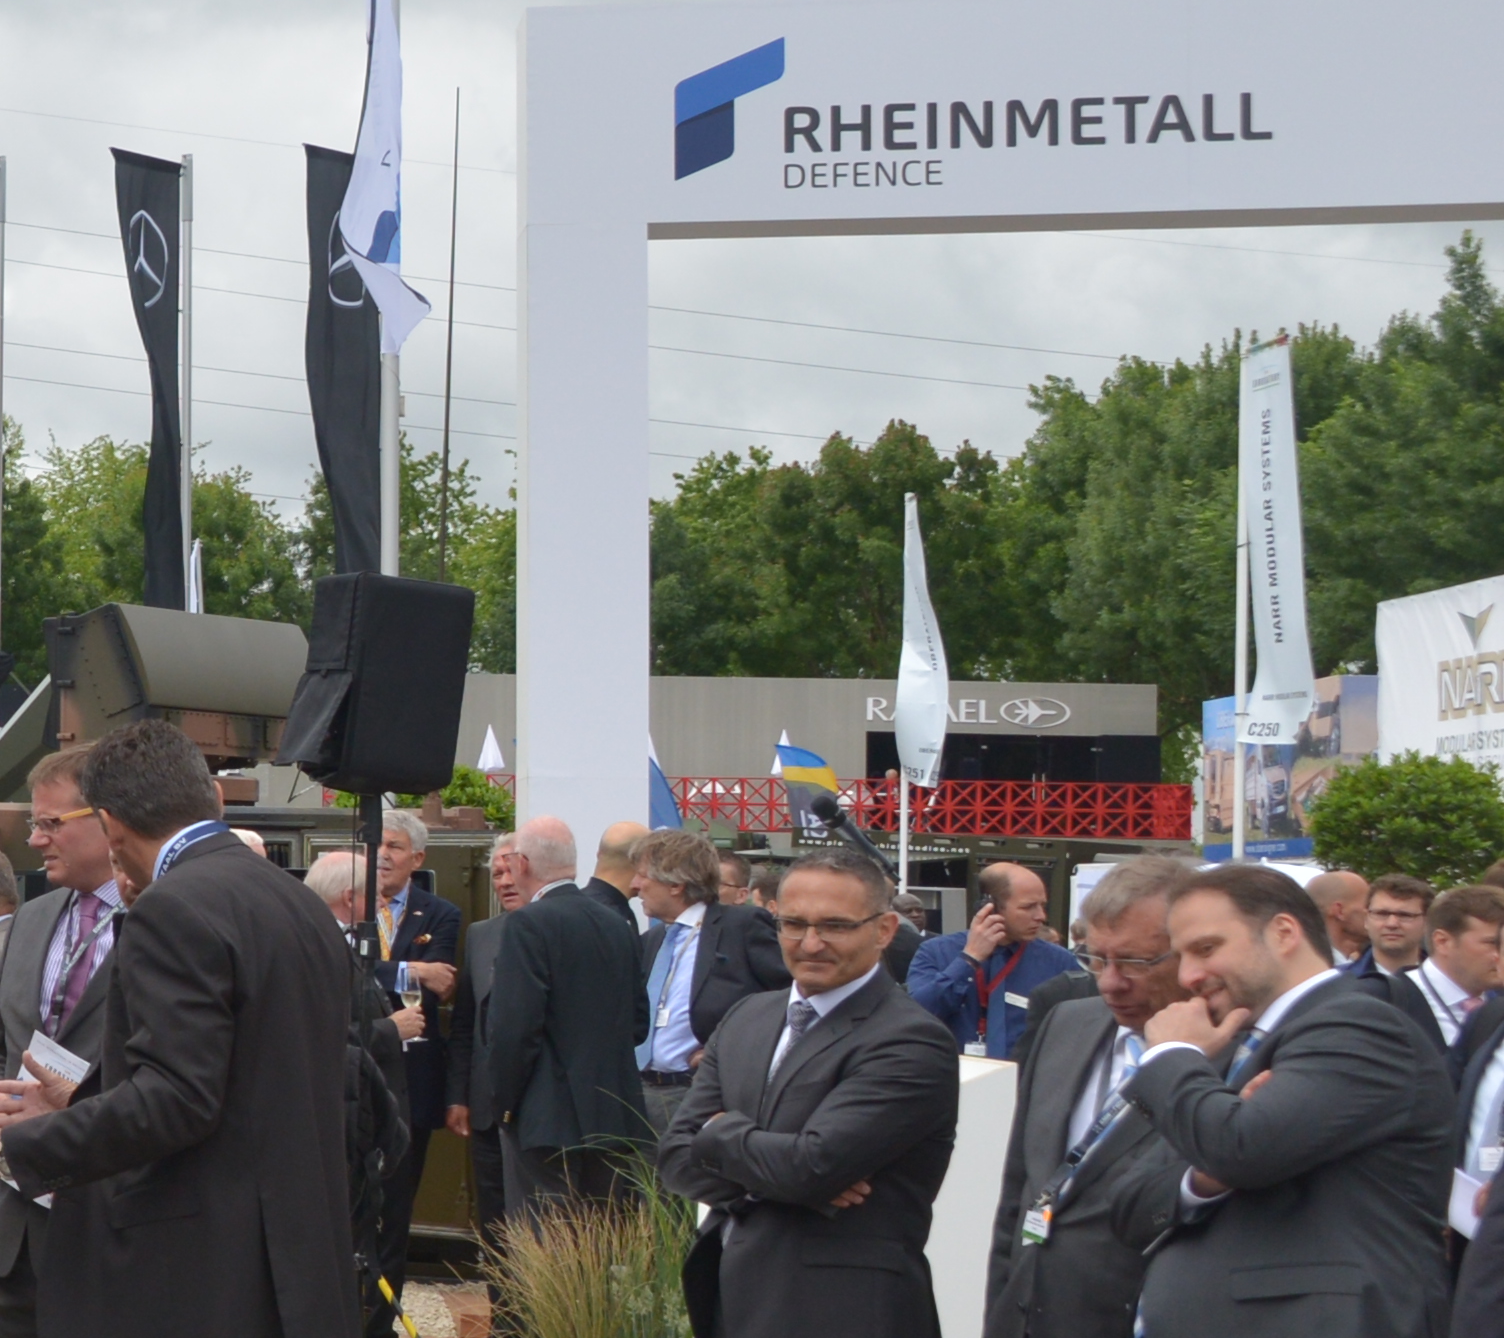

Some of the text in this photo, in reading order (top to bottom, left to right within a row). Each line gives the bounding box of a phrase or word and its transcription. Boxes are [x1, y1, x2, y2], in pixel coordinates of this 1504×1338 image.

[783, 92, 1273, 154] RHEINMETALL
[783, 160, 943, 189] DEFENCE
[1261, 408, 1284, 643] NARR MODULAR SYSTEMS
[1438, 653, 1504, 719] NAR
[1248, 722, 1280, 737] C250
